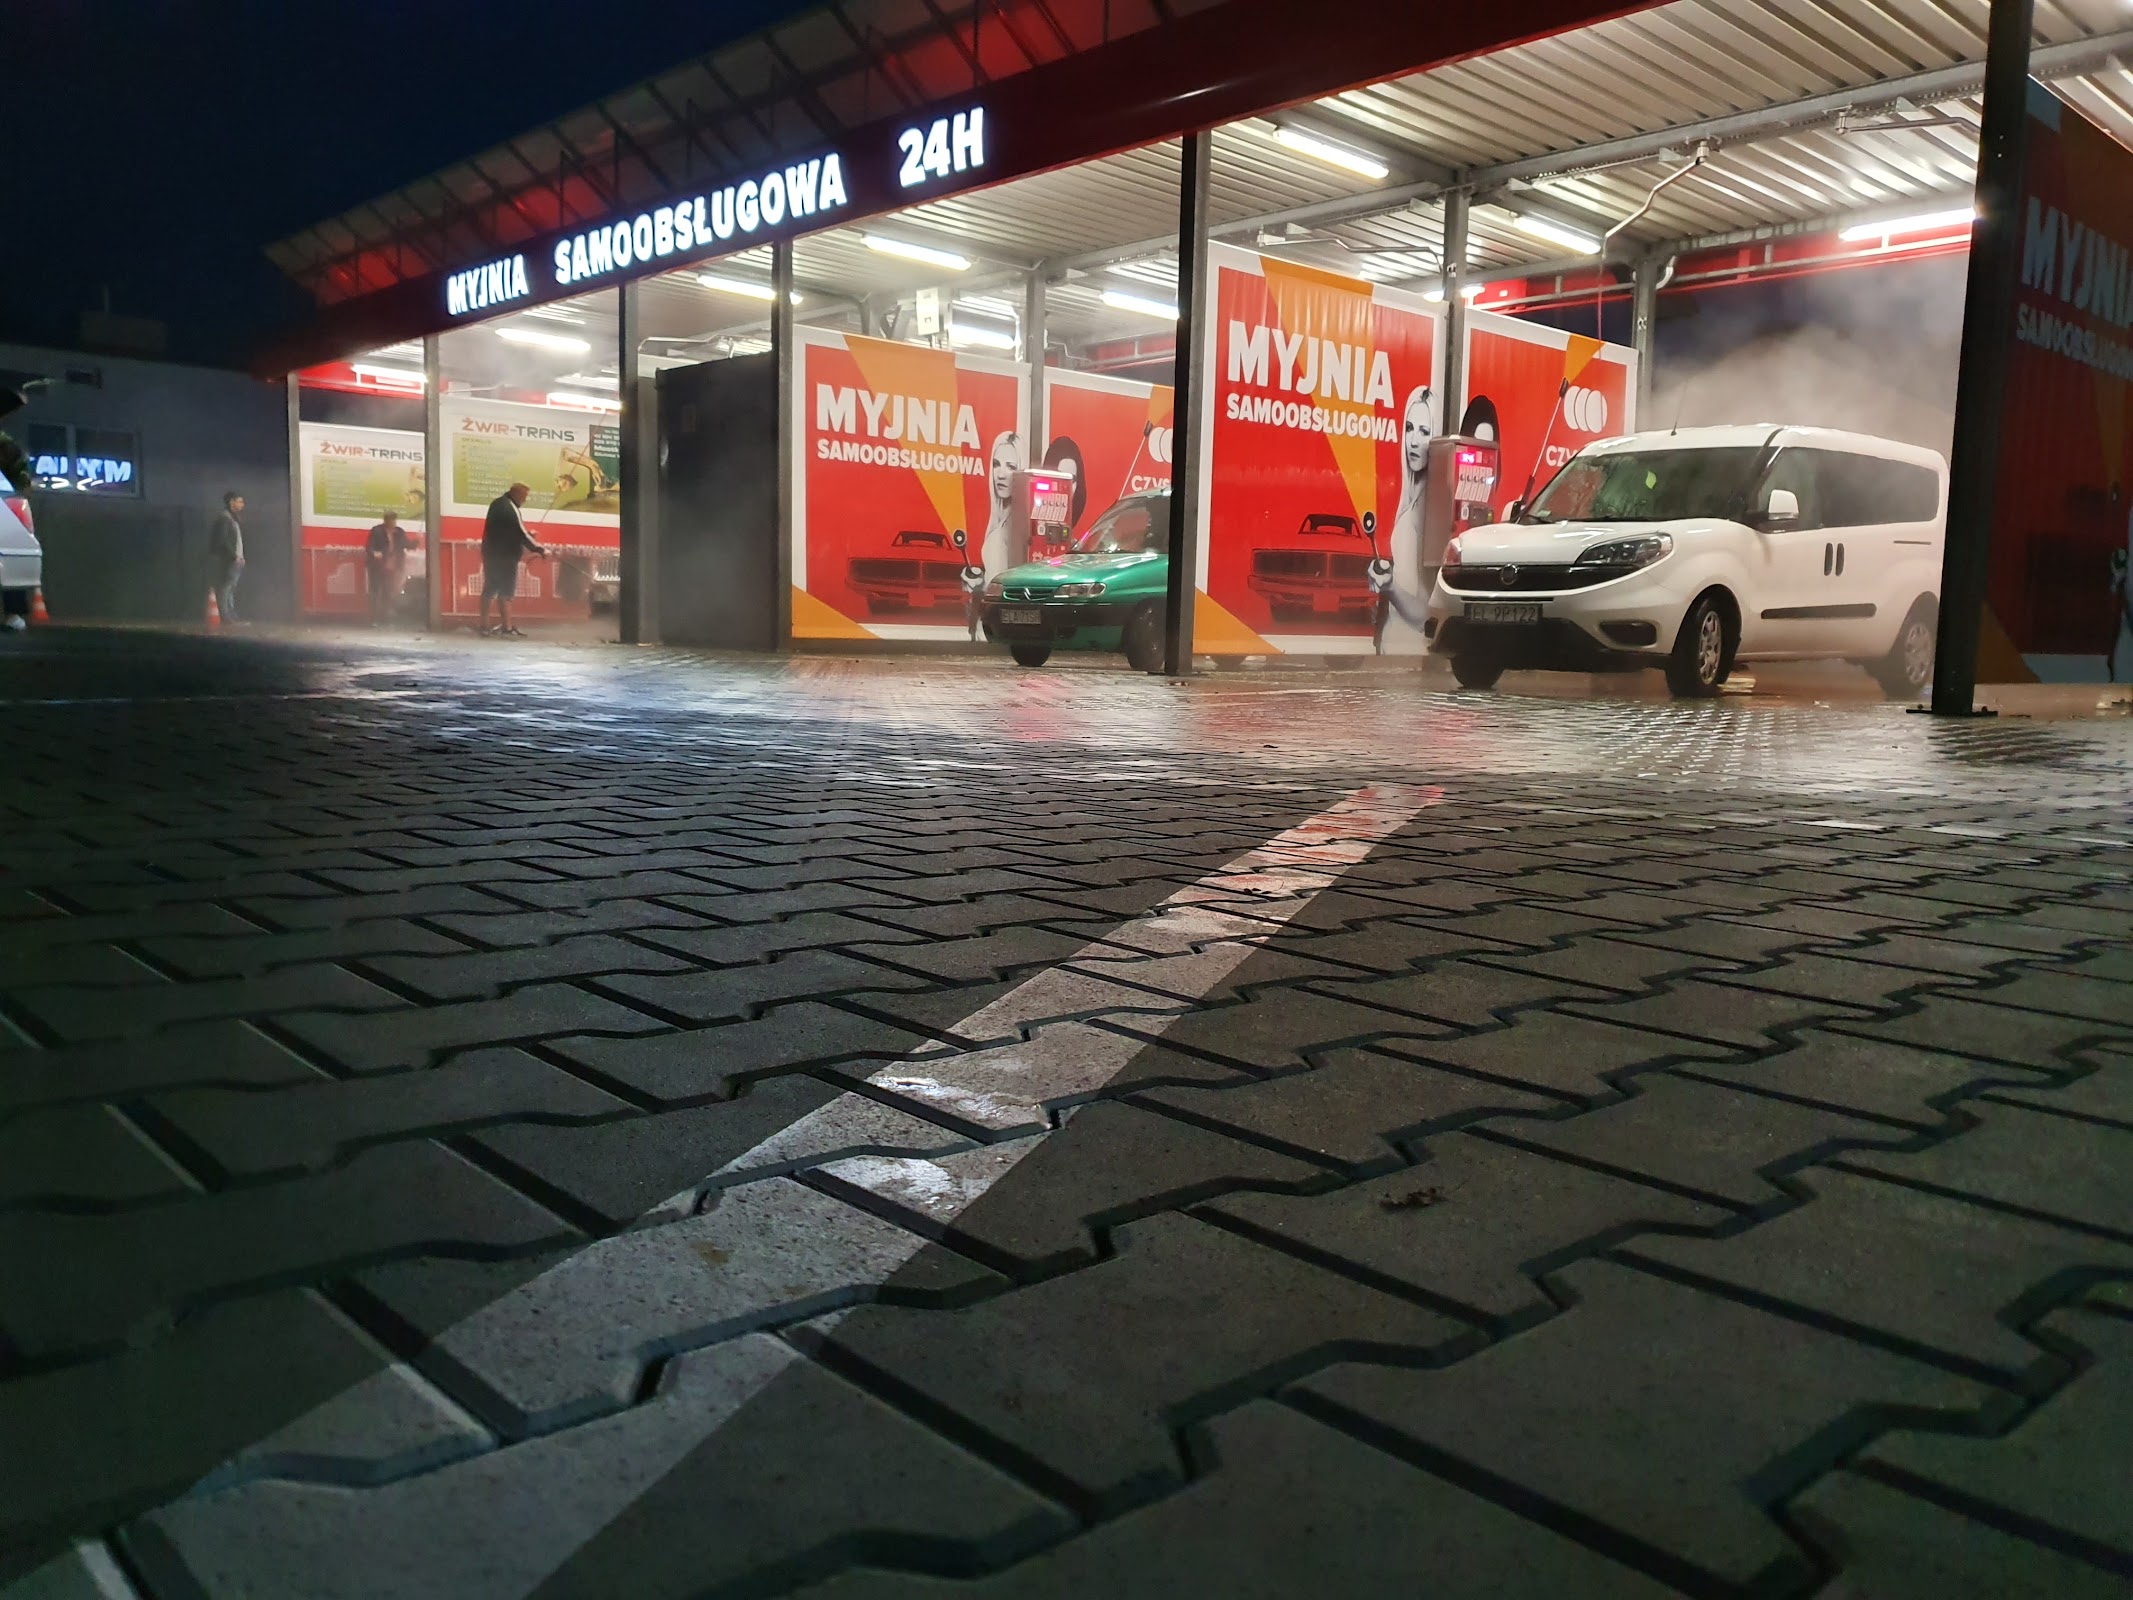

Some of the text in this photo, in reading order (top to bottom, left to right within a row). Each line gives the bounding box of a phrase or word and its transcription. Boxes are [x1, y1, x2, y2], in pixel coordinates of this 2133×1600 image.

[448, 107, 985, 316] MYJNIA SAMOOBSŁUGOWA 24H
[2021, 196, 2133, 330] MYJNI
[1228, 319, 1395, 409] MYJNIA
[461, 416, 575, 443] ŻWIR-TRANS
[816, 382, 981, 450] MYJNIA
[1226, 392, 1398, 444] SAMOOBSŁUGOWA
[319, 440, 423, 463] ŻWIR-TRANS
[816, 438, 985, 477] SAMOOBSŁUGOWA
